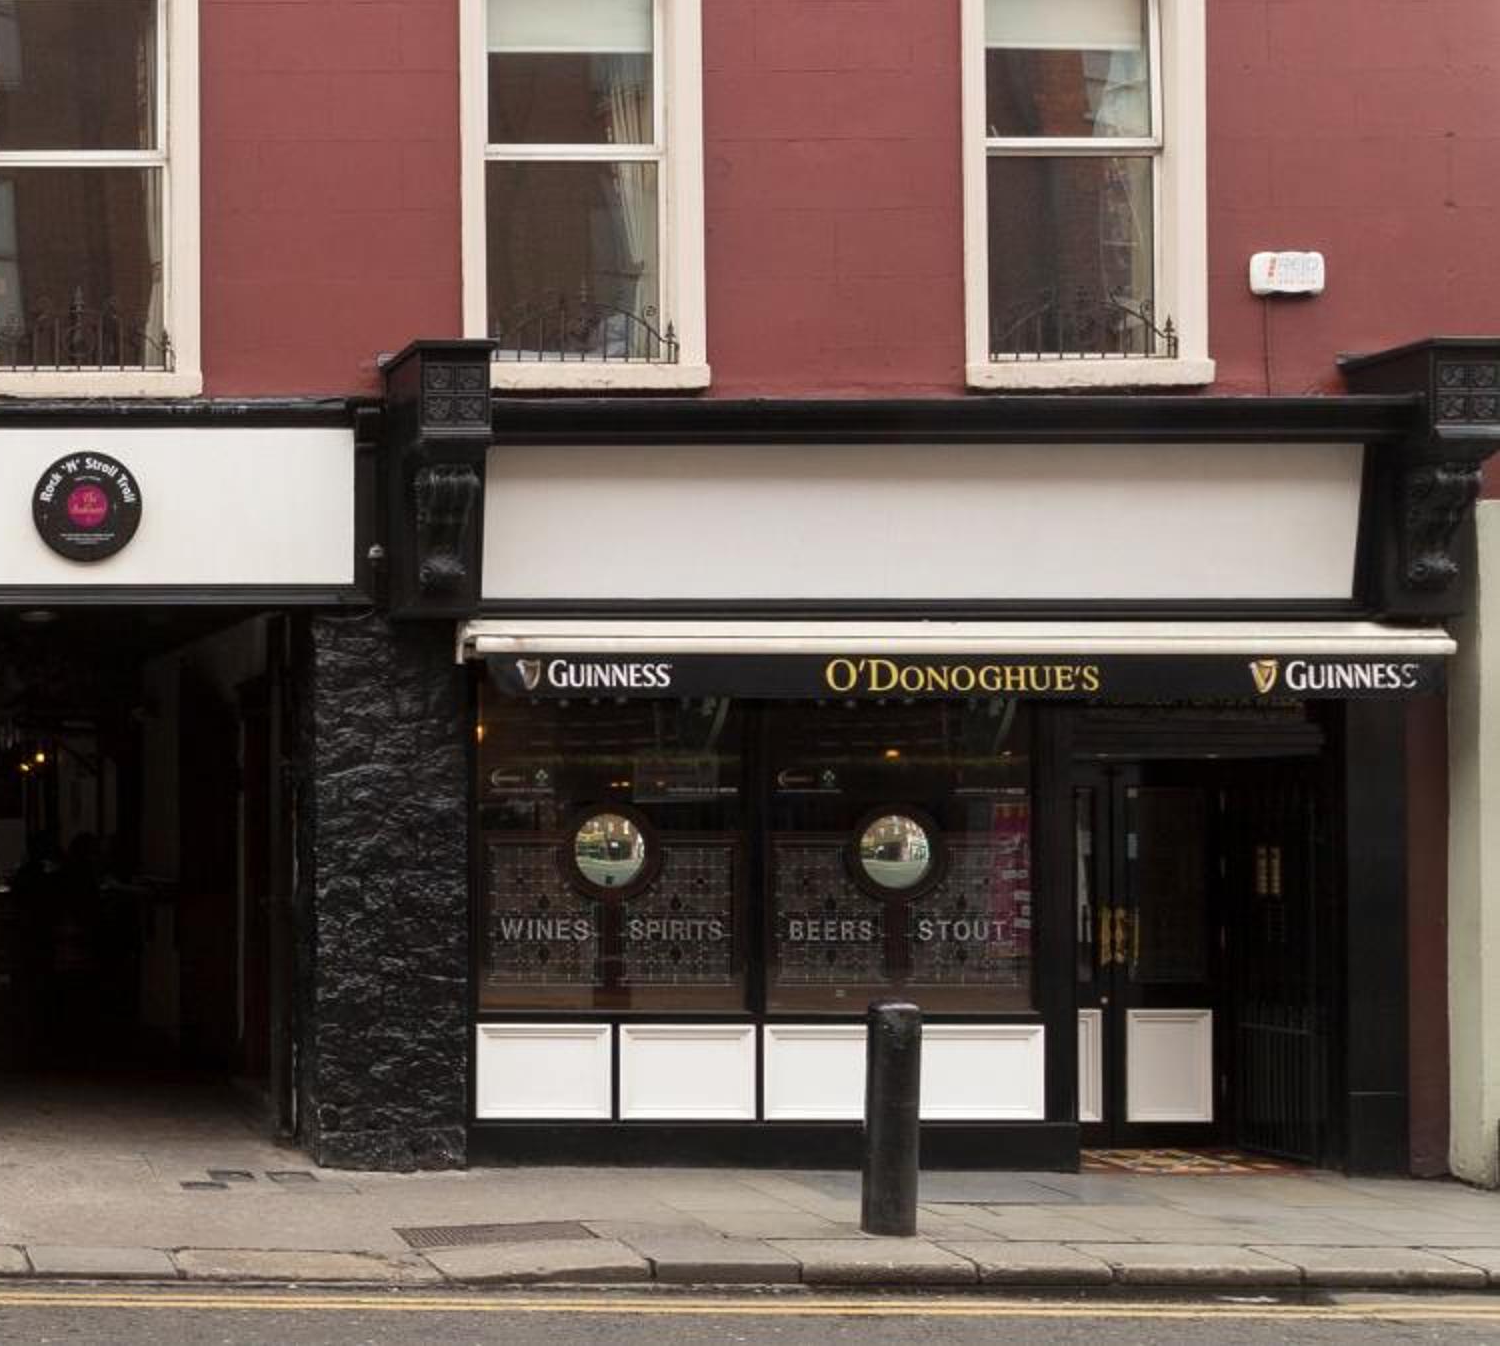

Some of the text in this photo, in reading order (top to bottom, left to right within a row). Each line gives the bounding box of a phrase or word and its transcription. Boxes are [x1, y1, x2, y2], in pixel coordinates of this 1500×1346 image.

[40, 472, 63, 503] Rock
[85, 457, 119, 477] Stroll
[548, 659, 1418, 691] GUINNESS O'DONOGHUE'S GUINNESS
[500, 918, 1007, 942] WINES SPIRITS BEERS STOUT
